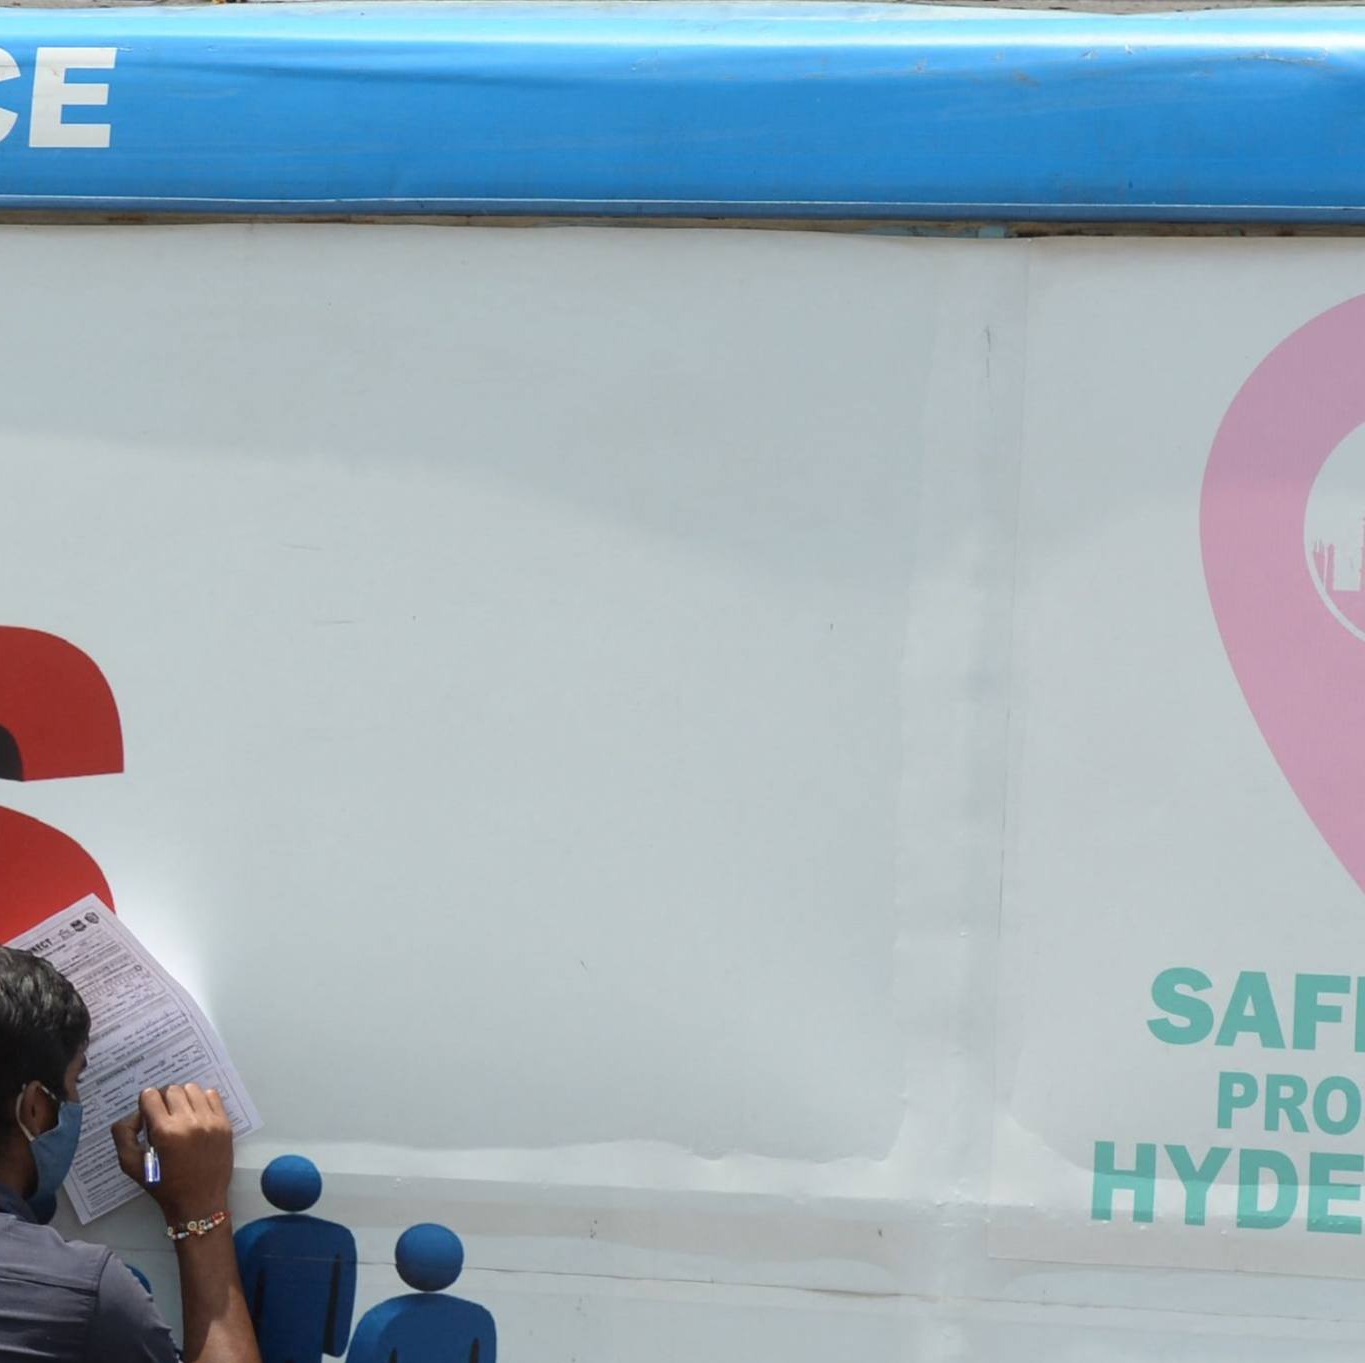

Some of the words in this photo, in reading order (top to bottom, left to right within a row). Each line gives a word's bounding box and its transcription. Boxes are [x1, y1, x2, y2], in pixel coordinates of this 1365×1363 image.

[1146, 966, 1365, 1053] SAF
[1217, 1071, 1362, 1136] PRO
[1091, 1140, 1365, 1235] HYDE
